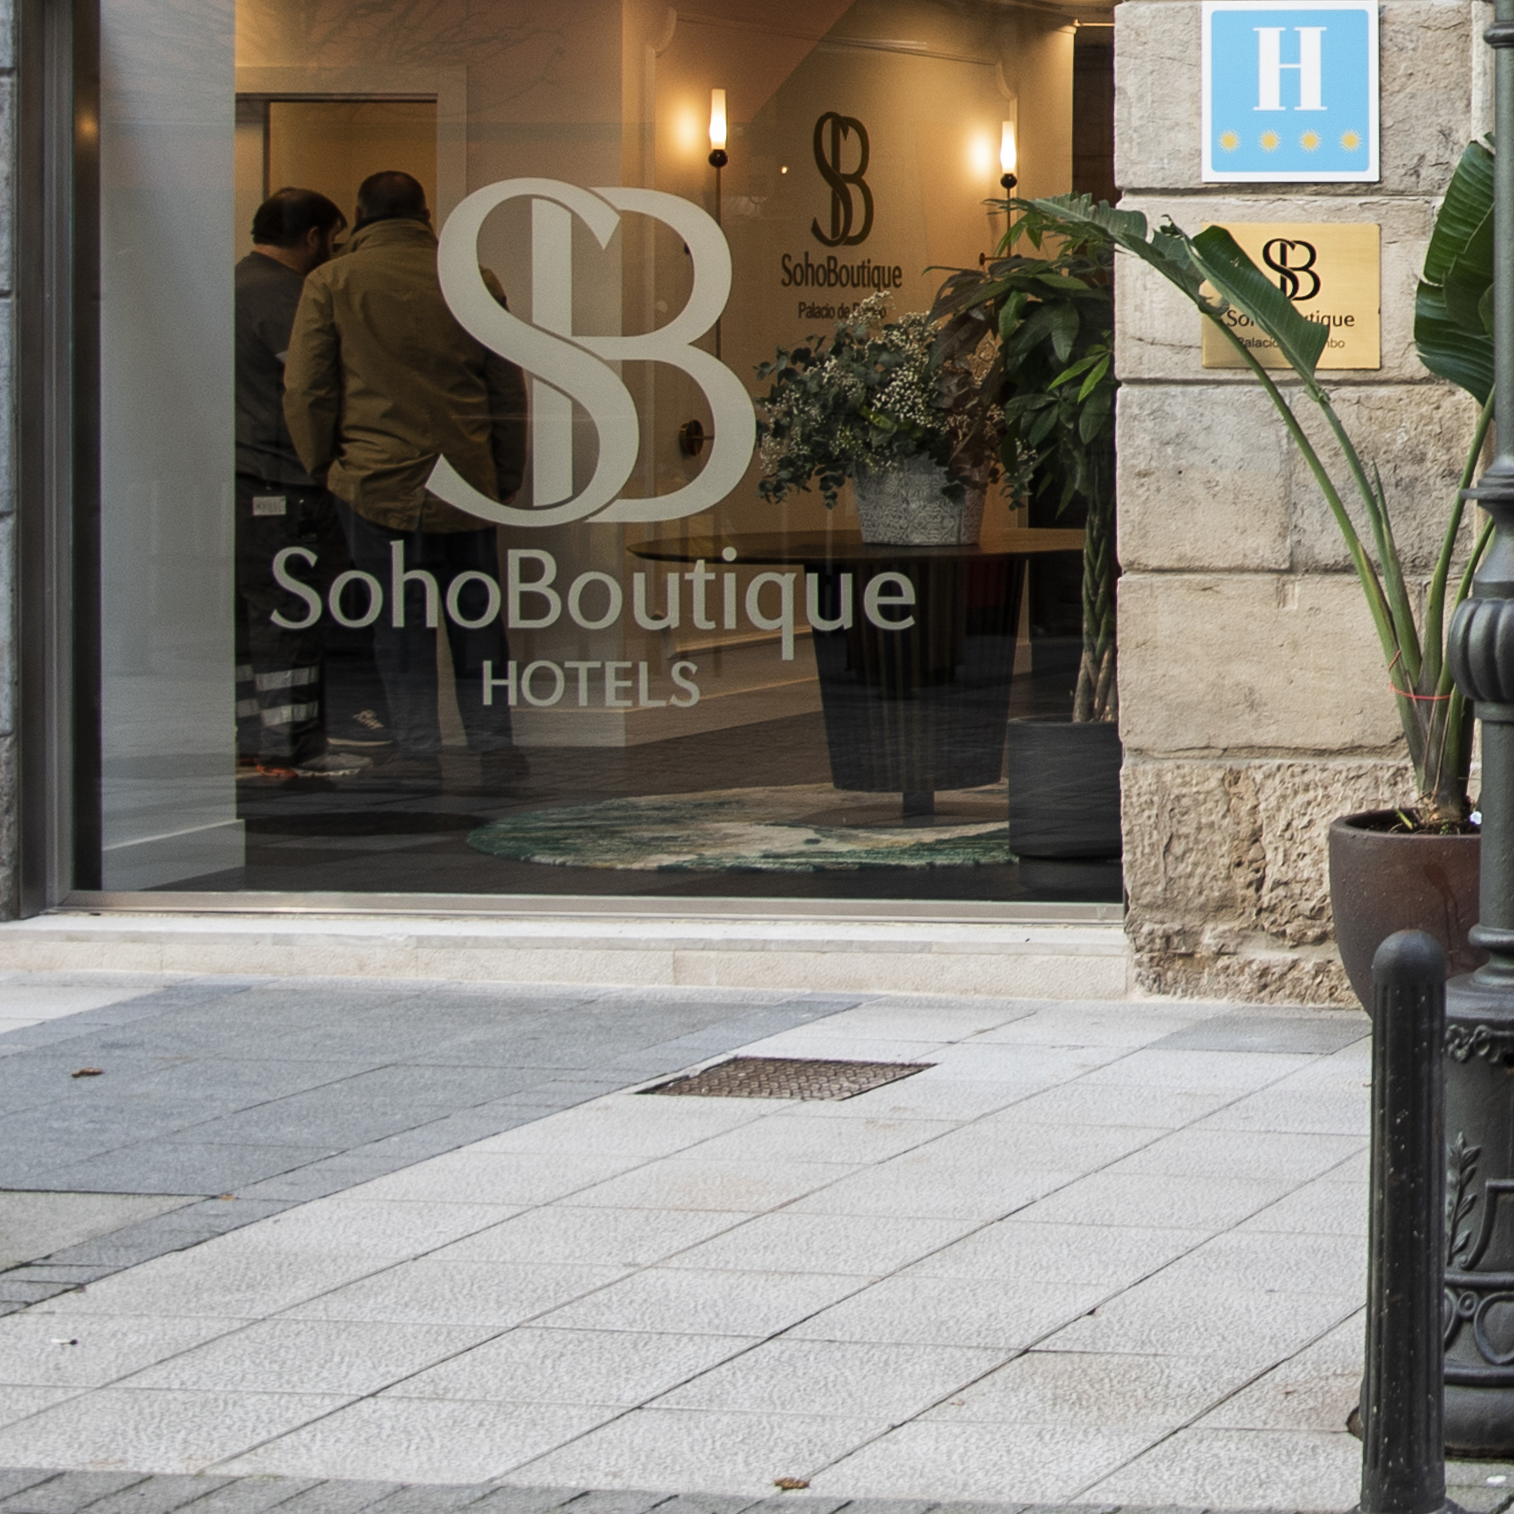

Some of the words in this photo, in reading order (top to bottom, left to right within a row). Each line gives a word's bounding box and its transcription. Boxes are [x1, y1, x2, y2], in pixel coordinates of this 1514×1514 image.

[1253, 27, 1328, 111] H
[781, 251, 902, 292] SohoBoutique
[798, 301, 835, 319] Palacio
[837, 302, 850, 319] de
[270, 540, 916, 661] SohoBoutique
[482, 660, 701, 708] HOTELS
